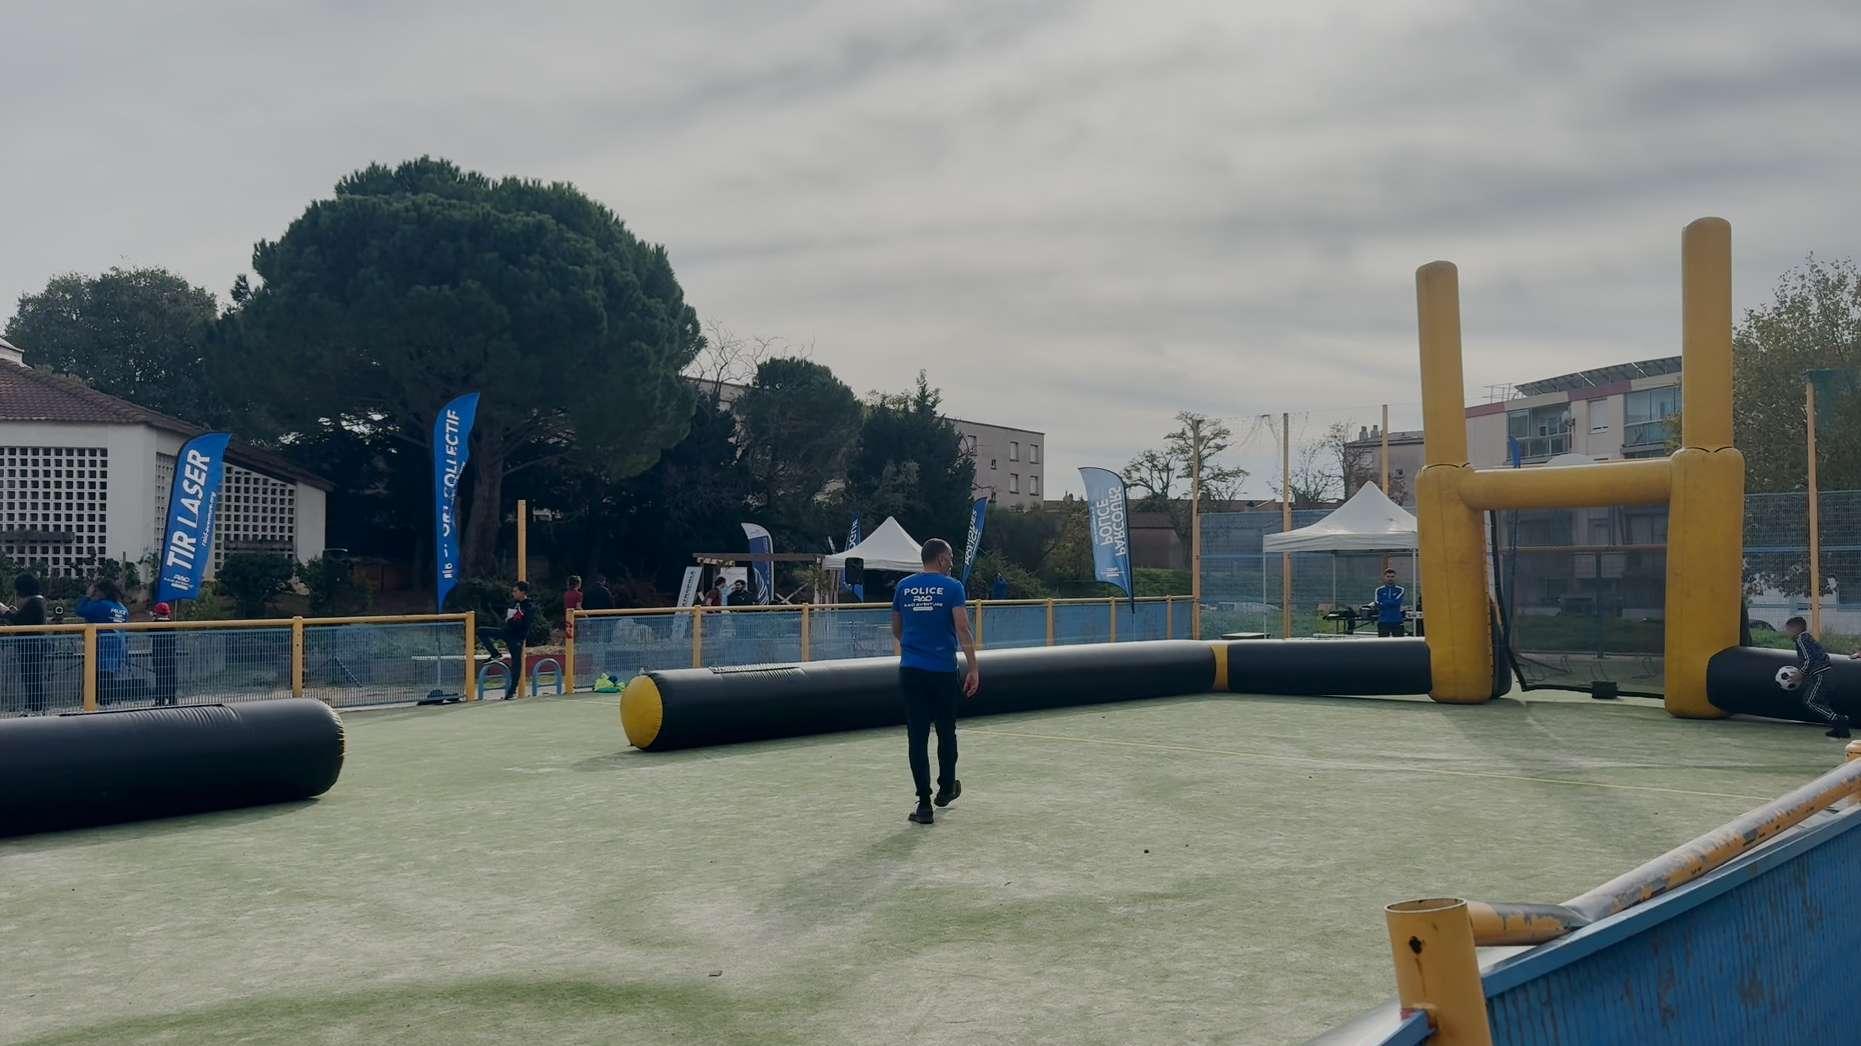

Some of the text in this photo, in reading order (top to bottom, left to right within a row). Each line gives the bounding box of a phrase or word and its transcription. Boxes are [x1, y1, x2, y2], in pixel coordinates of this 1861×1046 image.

[177, 449, 210, 528] LASER
[167, 531, 196, 570] TIR
[904, 587, 944, 596] POLICE
